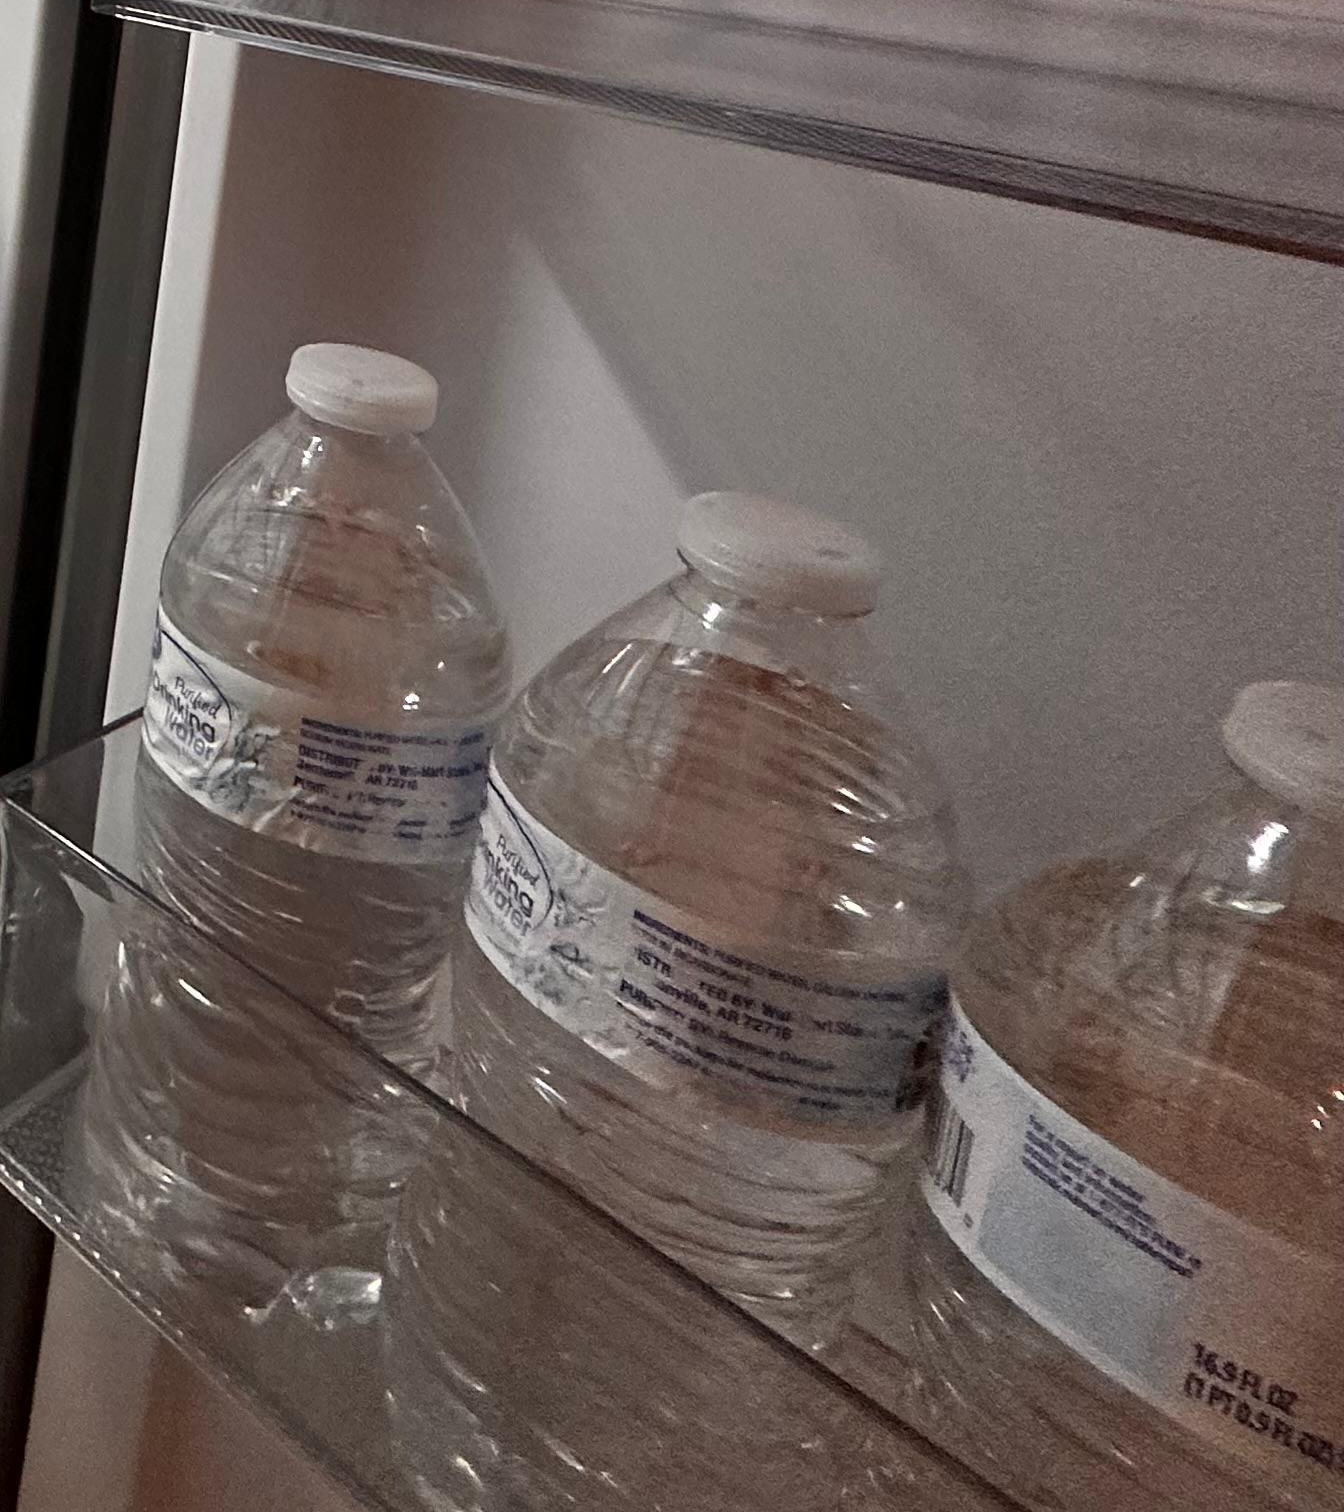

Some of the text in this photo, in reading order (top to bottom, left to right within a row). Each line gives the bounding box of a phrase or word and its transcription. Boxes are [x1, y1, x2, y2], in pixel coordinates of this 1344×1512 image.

[152, 671, 216, 744] Drinking
[175, 676, 223, 719] Purified
[164, 705, 215, 761] Water
